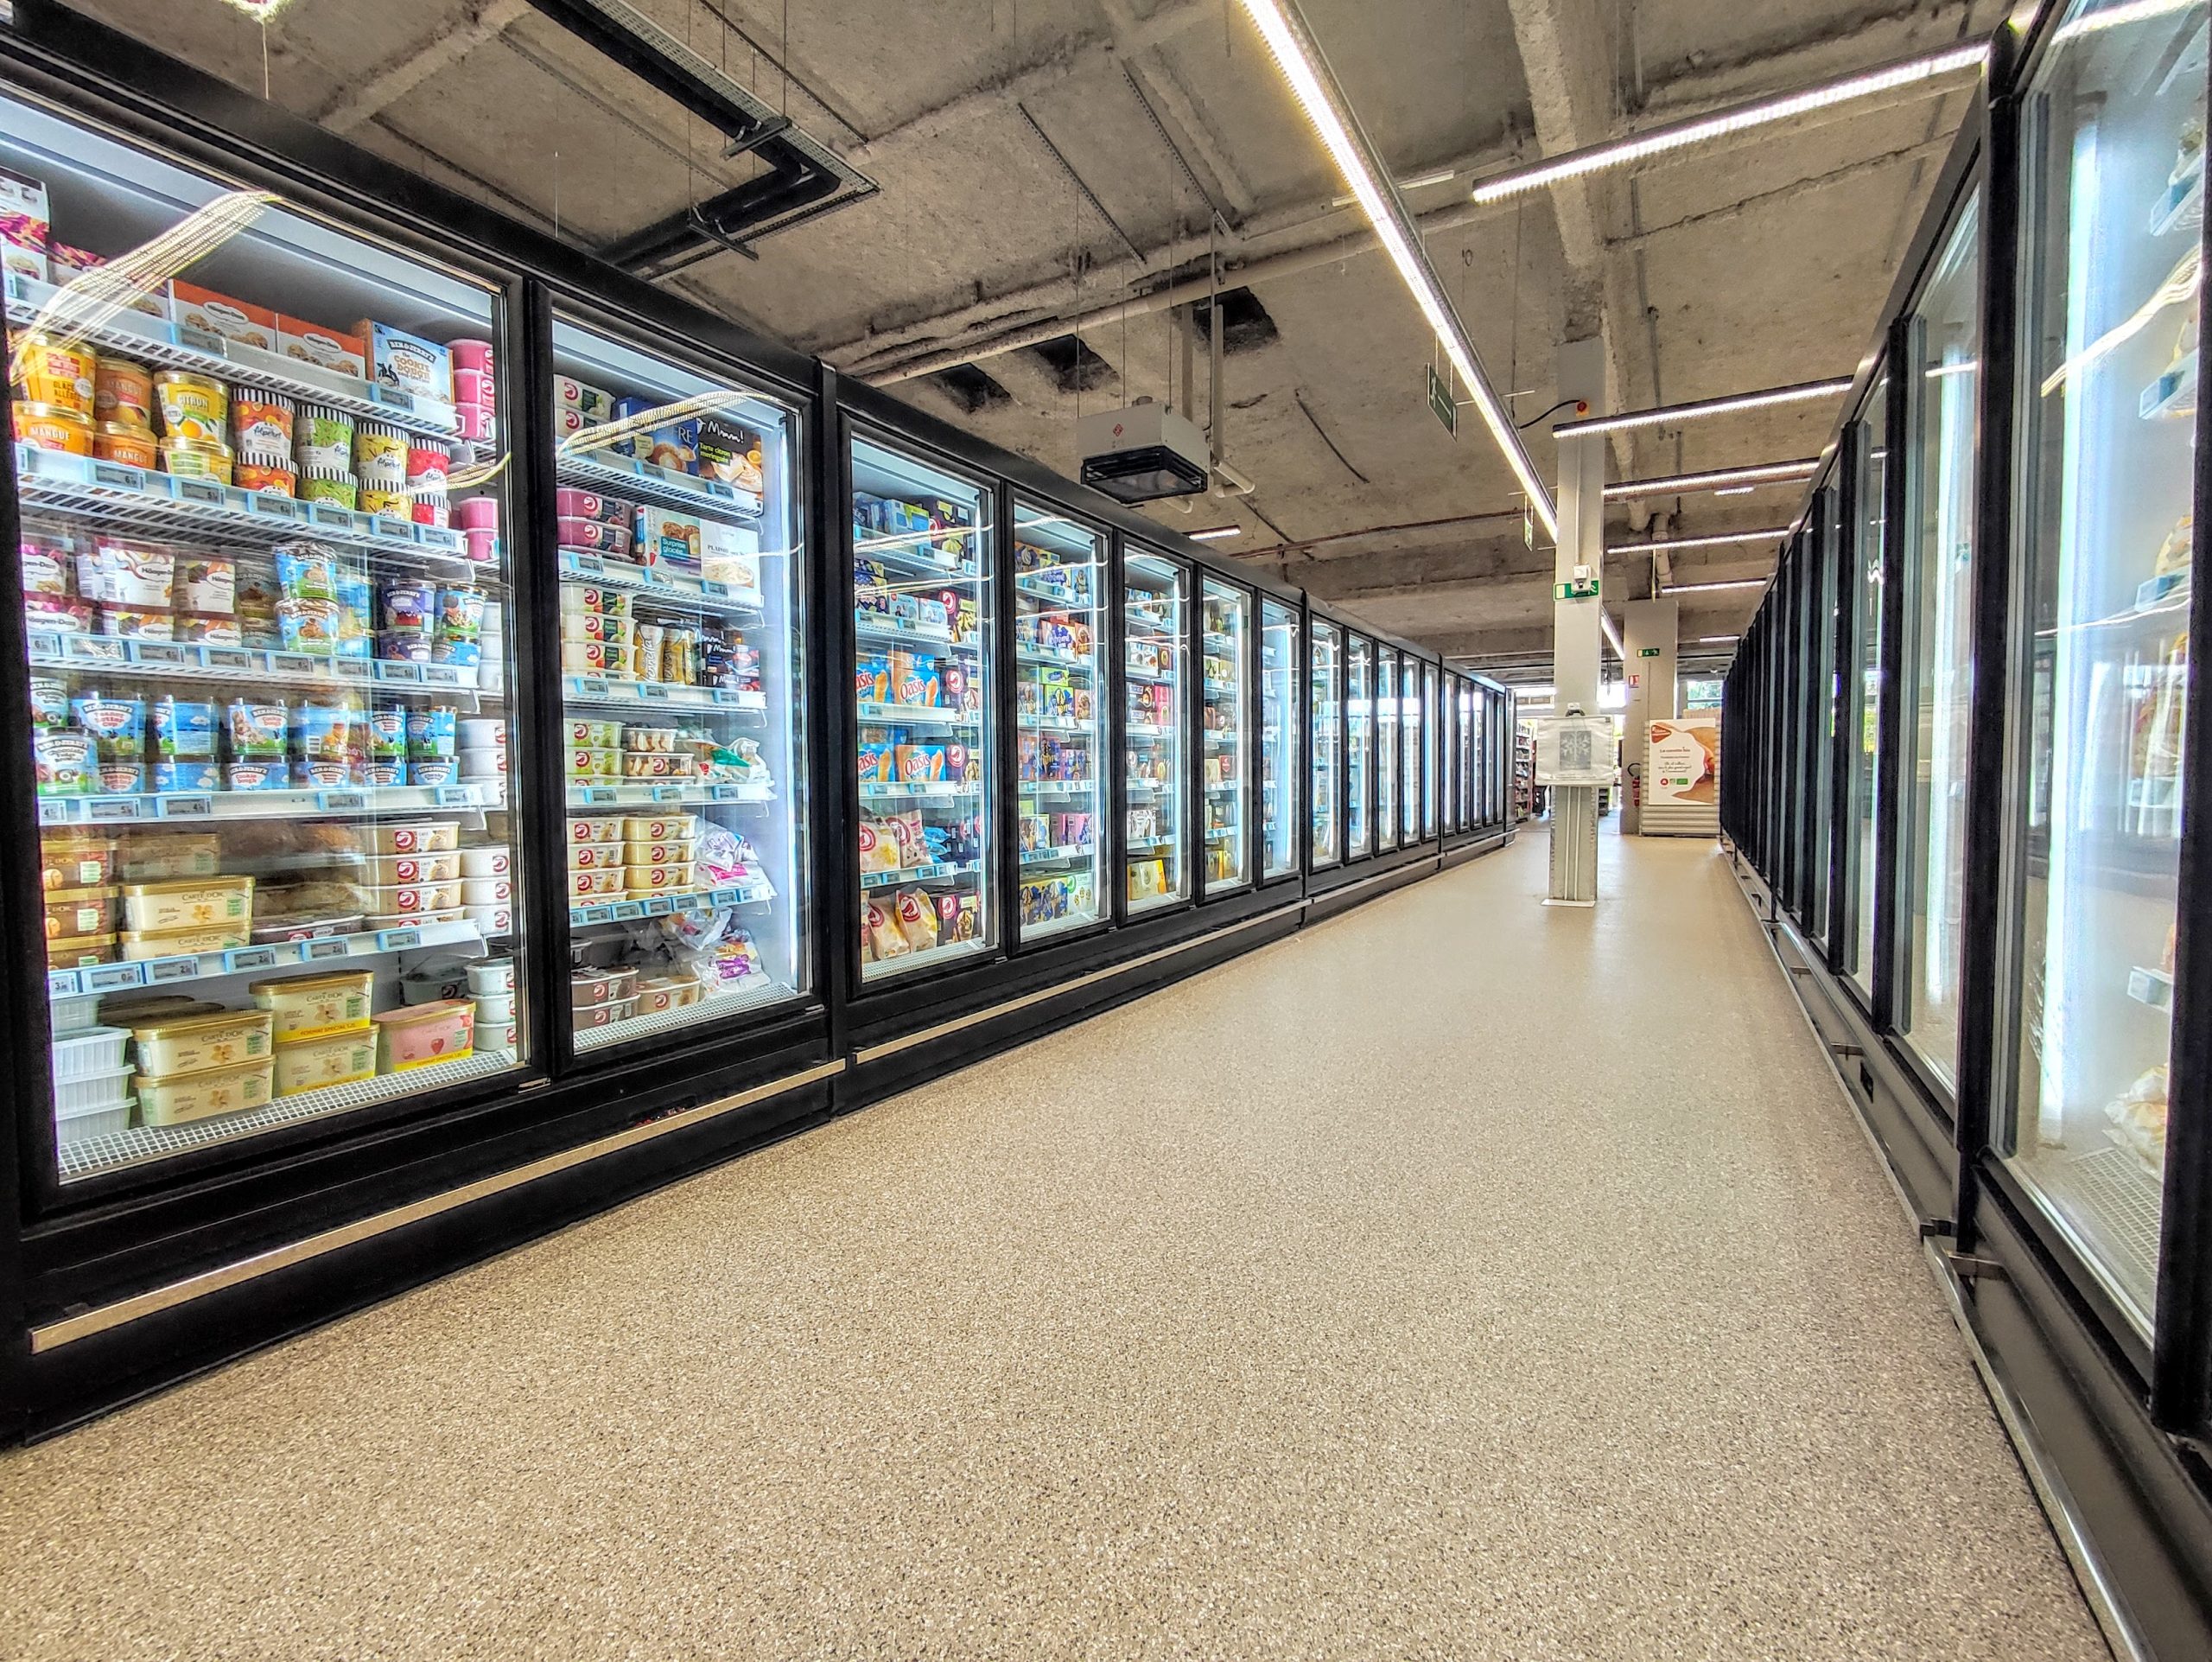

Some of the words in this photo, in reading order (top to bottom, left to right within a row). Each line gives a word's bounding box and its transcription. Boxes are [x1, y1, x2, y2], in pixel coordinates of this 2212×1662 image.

[393, 354, 430, 372] COOKIE
[397, 363, 430, 379] DOUGH
[107, 380, 143, 394] MANGUE
[177, 394, 208, 408] CITRON
[30, 426, 70, 441] MANGUE
[662, 538, 686, 549] Surprise
[900, 678, 926, 700] Oasis
[905, 753, 931, 776] Oasis
[181, 892, 205, 901] CARTE
